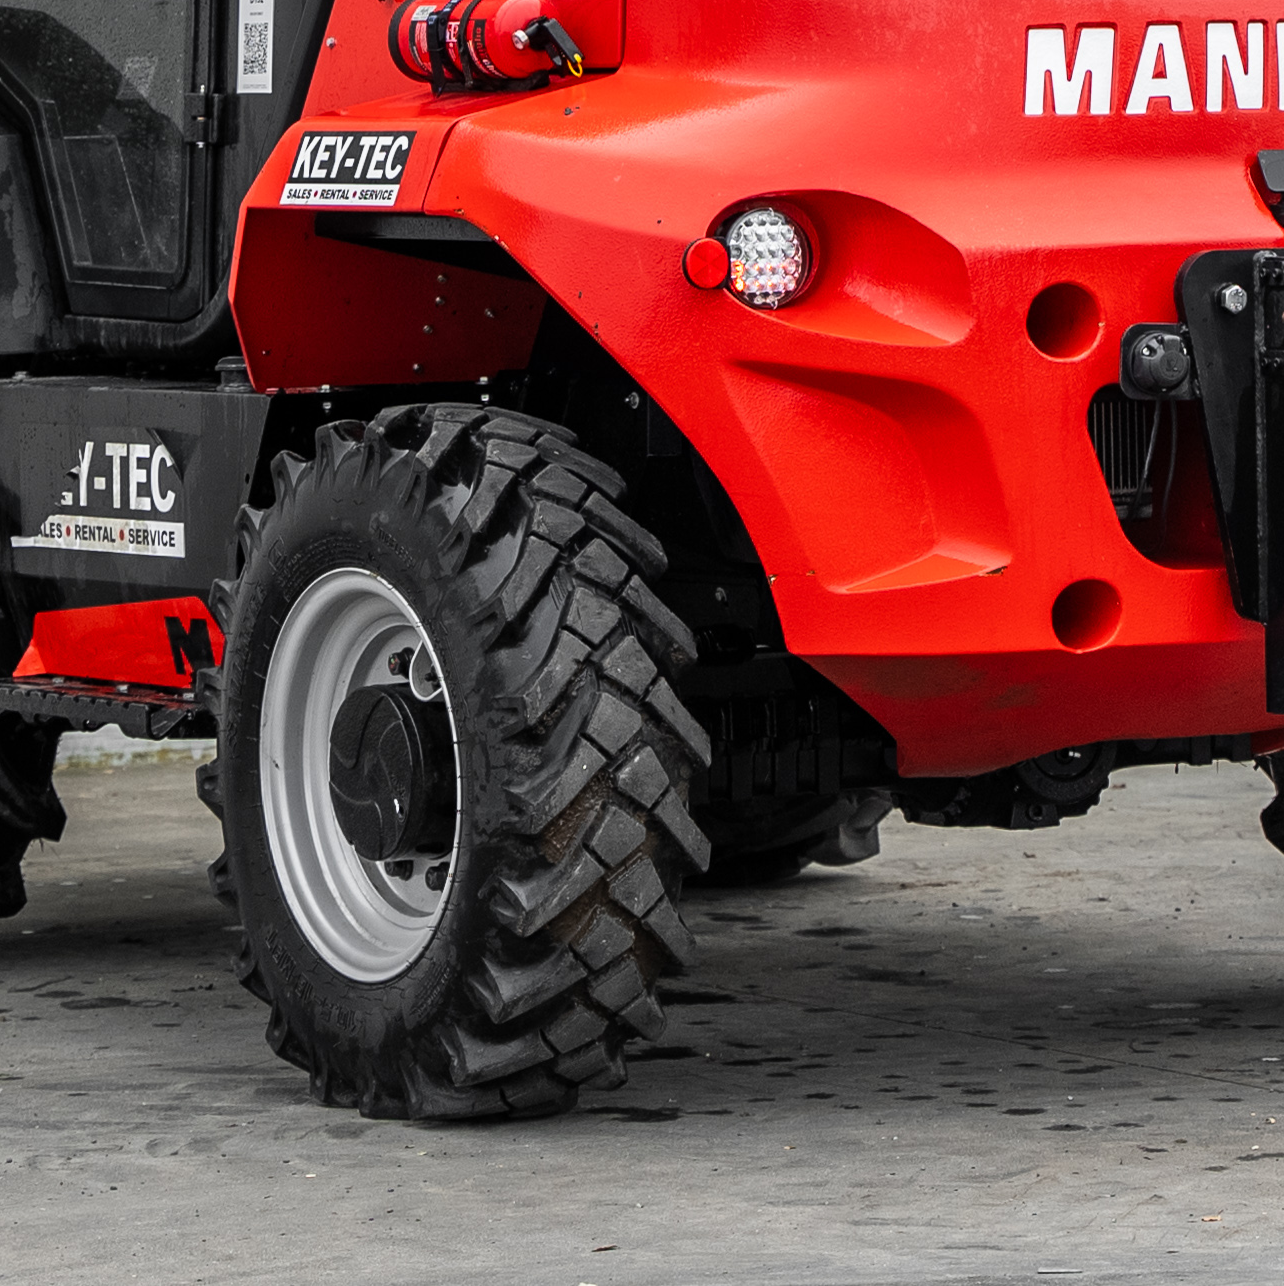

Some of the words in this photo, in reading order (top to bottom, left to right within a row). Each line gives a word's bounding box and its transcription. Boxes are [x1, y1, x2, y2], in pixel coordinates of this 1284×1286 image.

[292, 135, 409, 180] KEY-TEC
[287, 188, 313, 199] SALES
[319, 189, 350, 200] RENTAL
[358, 189, 394, 200] SERVICE
[74, 524, 116, 543] RENTAL
[128, 528, 176, 547] SERVICE
